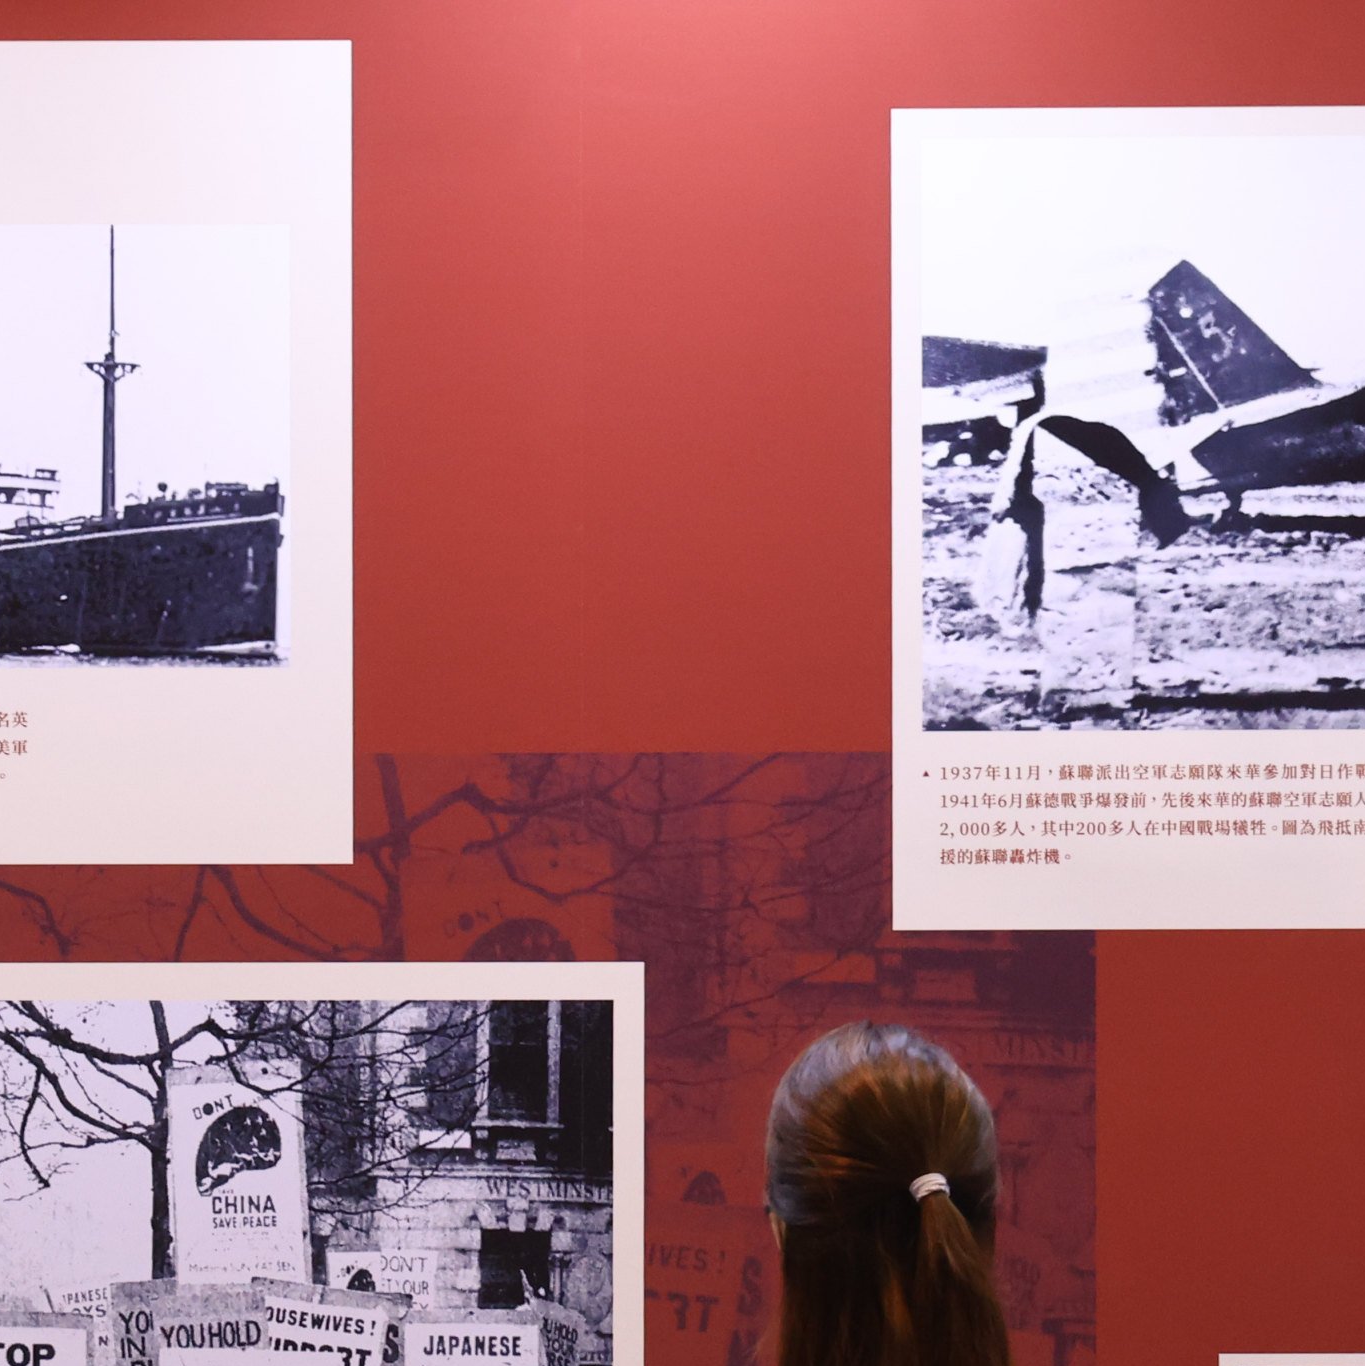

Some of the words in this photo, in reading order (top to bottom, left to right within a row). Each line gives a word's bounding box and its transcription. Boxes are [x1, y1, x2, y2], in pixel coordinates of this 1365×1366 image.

[939, 847, 1072, 866] 援的蘇聯轟炸機。
[211, 1194, 277, 1215] CHINA
[212, 1216, 237, 1229] SAVE
[242, 1215, 277, 1228] PEACE
[160, 1324, 206, 1349] YOU
[208, 1319, 261, 1348] HOLD
[120, 1335, 146, 1359] IN
[423, 1335, 522, 1358] JAPANESE
